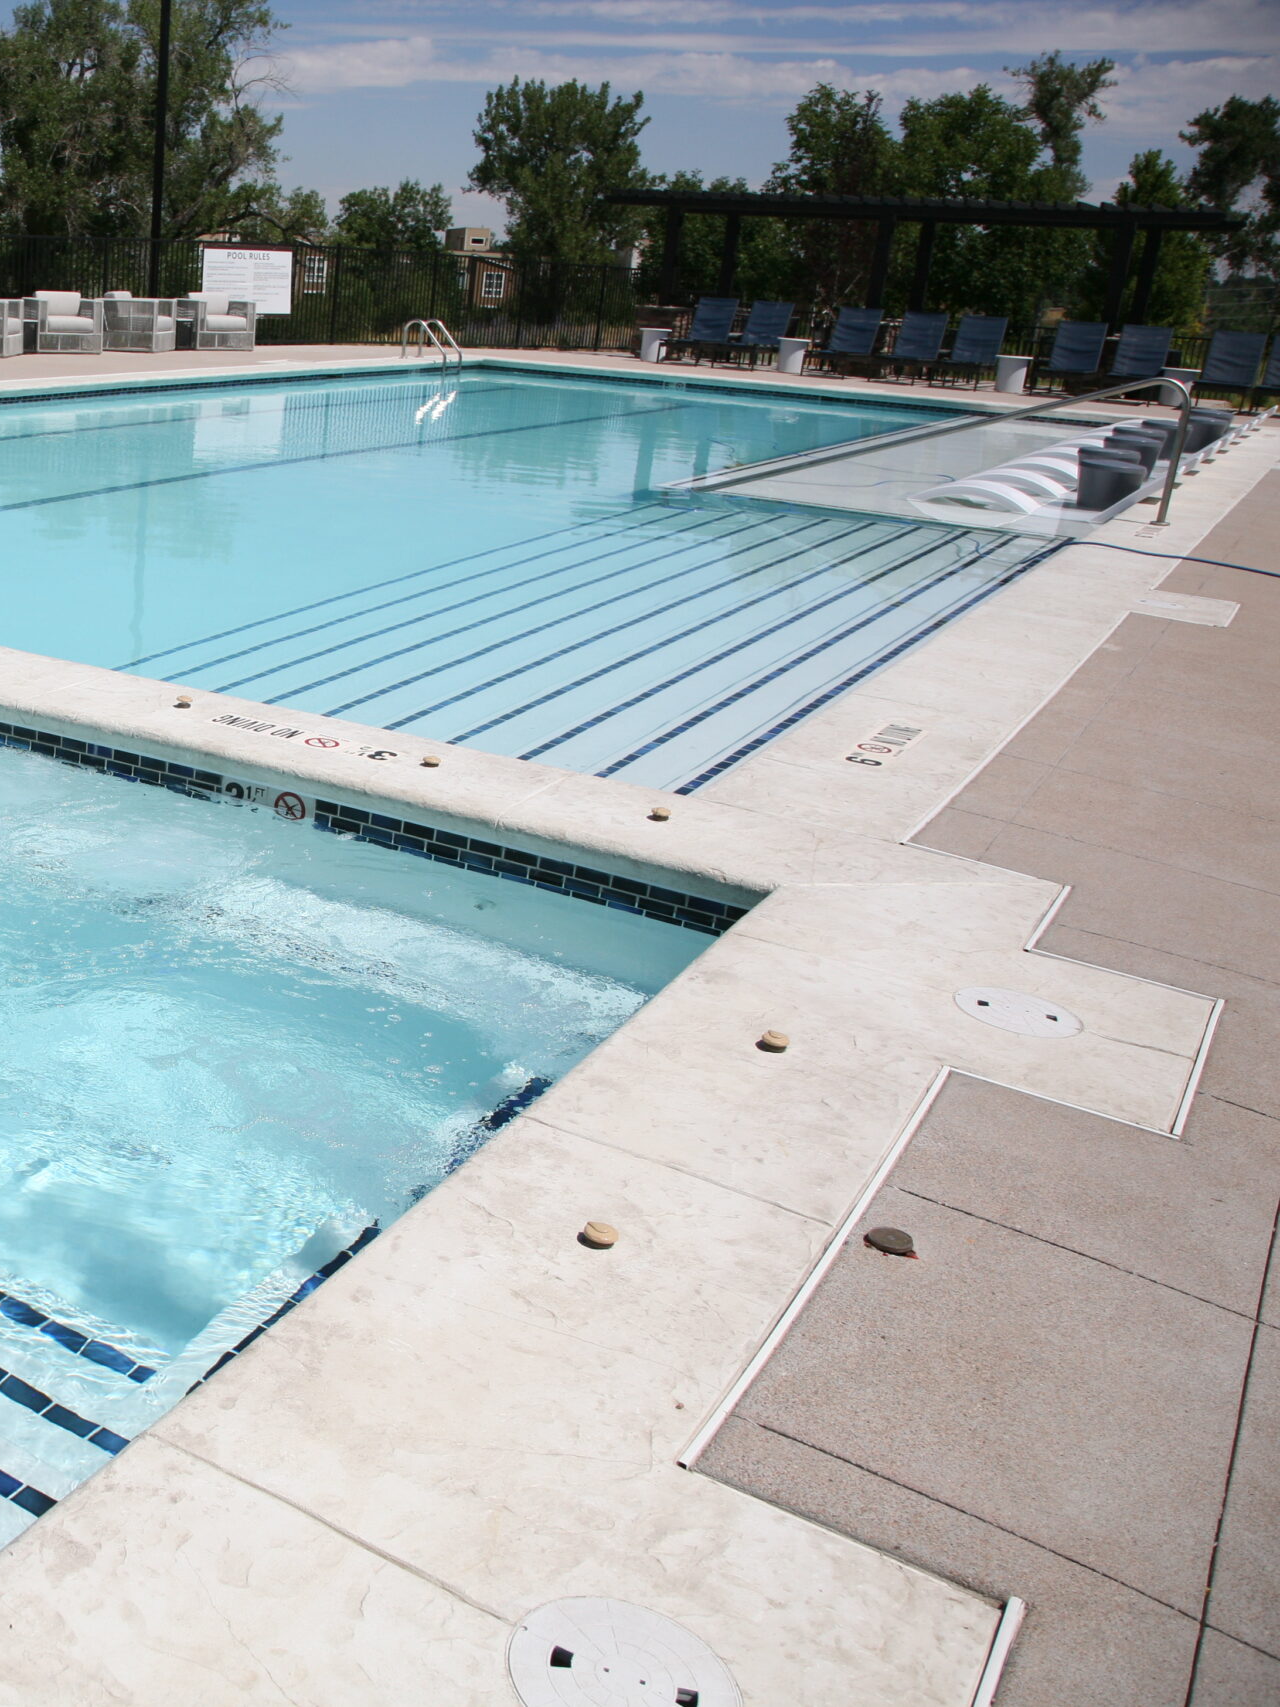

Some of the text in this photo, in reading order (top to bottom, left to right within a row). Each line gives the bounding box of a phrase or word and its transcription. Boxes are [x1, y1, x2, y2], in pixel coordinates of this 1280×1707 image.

[227, 252, 271, 261] POOL RULES
[212, 714, 276, 733] DIVING
[270, 725, 305, 739] NO
[845, 756, 883, 767] 6
